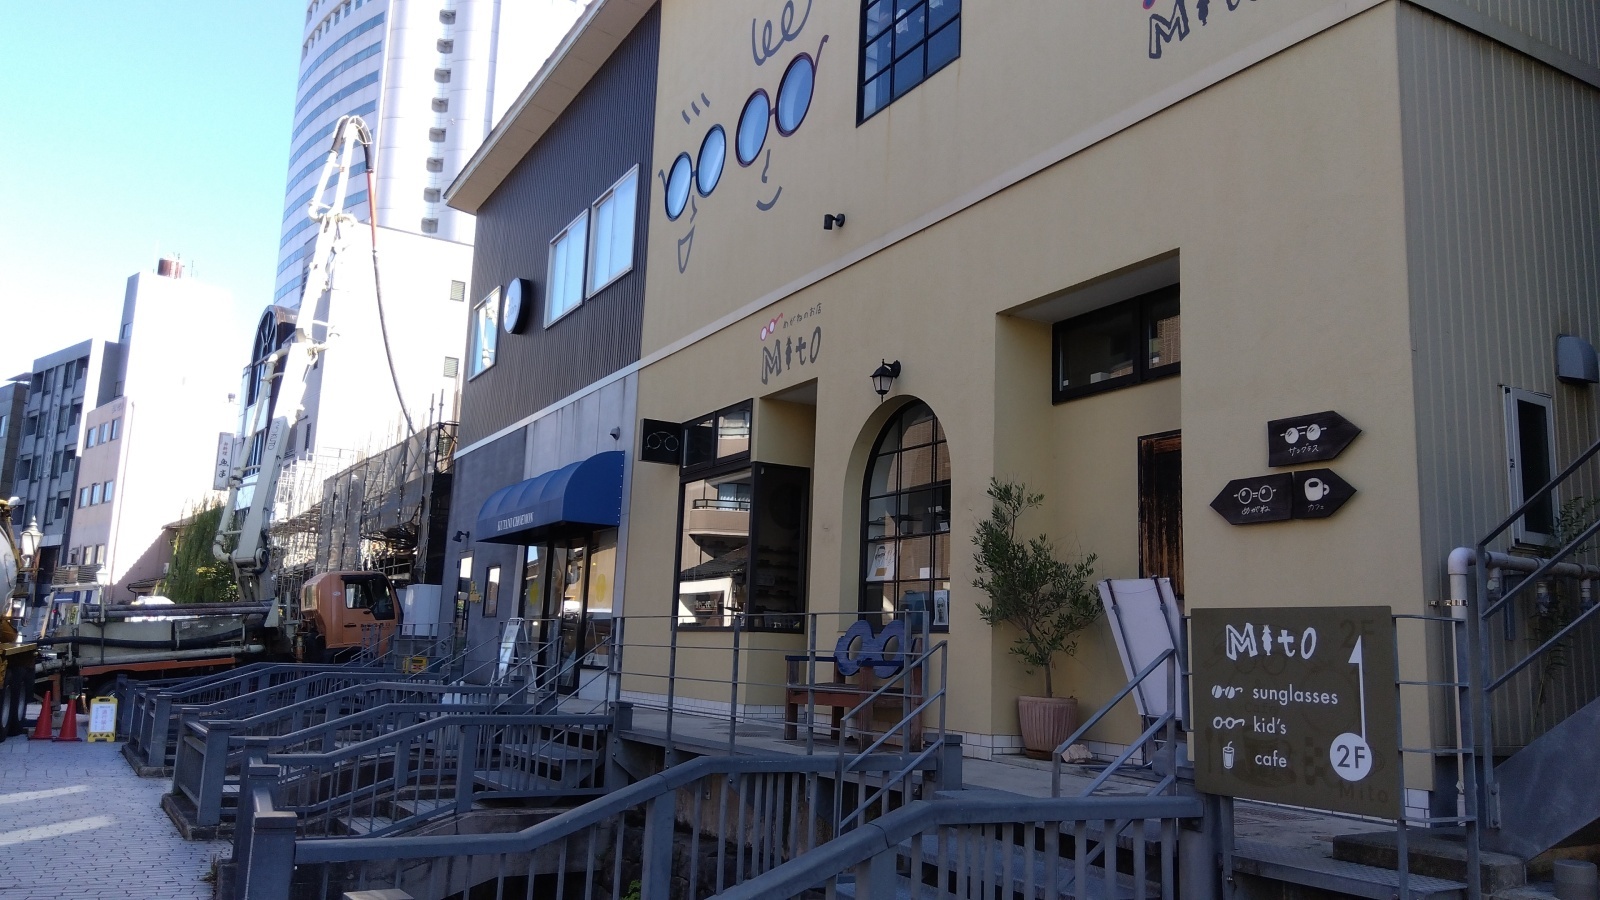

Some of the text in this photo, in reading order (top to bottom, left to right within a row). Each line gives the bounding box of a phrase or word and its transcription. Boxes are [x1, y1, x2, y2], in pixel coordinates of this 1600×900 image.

[1288, 443, 1319, 456] サングラス
[1241, 504, 1271, 516] めがね
[1307, 504, 1325, 512] カフェ
[1252, 684, 1338, 706] sunglasses
[1253, 716, 1287, 735] kid's
[1255, 750, 1287, 768] cafe
[1337, 744, 1366, 769] 2F
